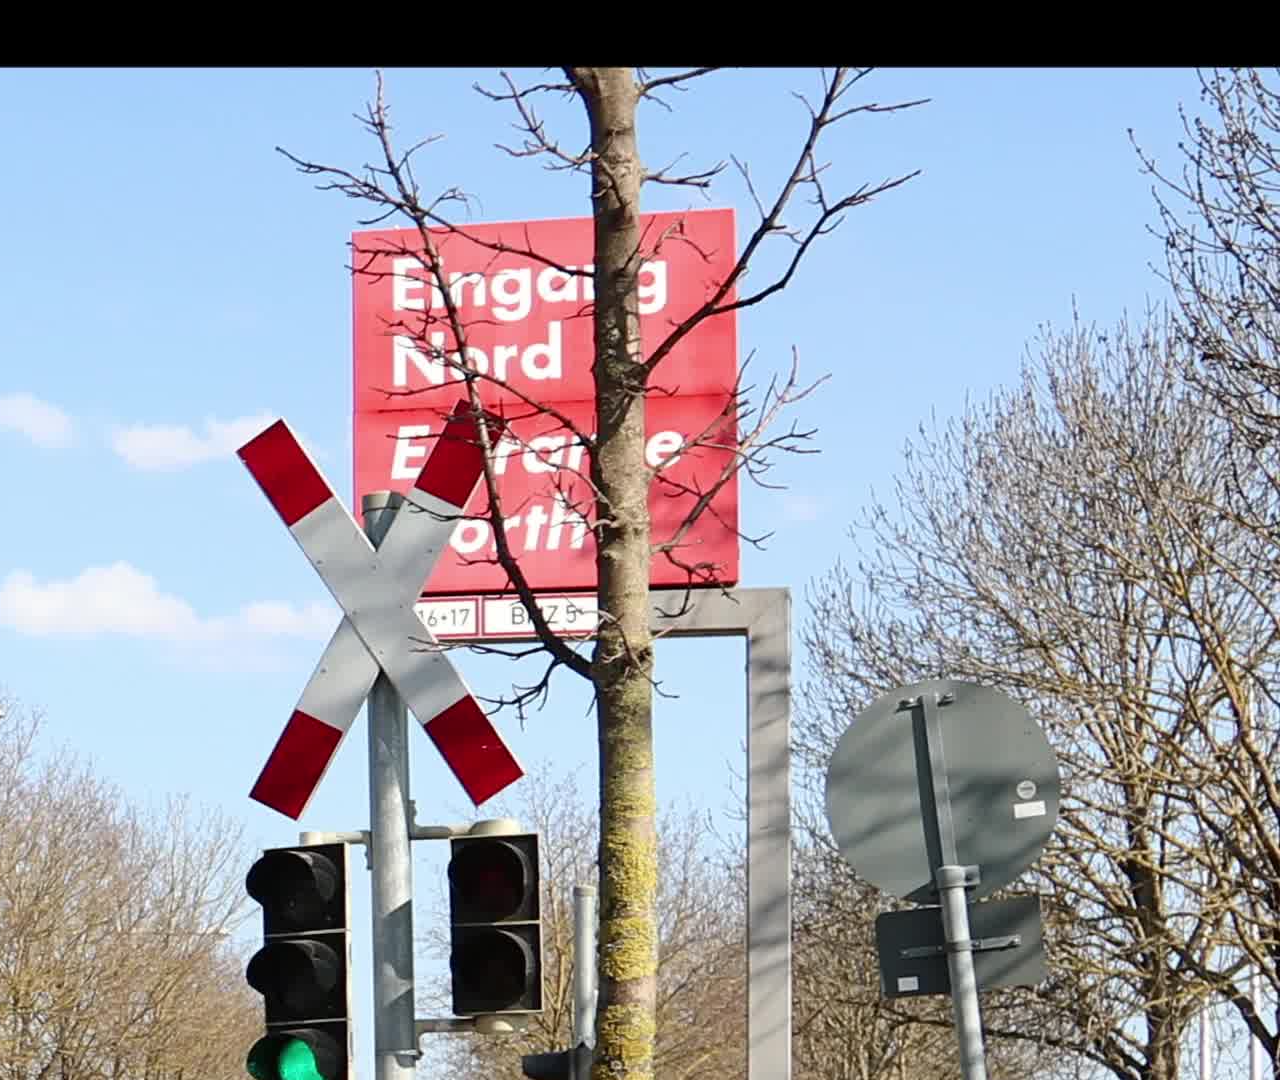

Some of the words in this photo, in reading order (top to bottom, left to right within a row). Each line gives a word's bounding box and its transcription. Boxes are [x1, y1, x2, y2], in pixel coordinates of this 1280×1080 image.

[392, 255, 668, 321] Eingag
[392, 320, 563, 387] Nord
[448, 492, 587, 554] orth
[511, 605, 557, 626] BZ
